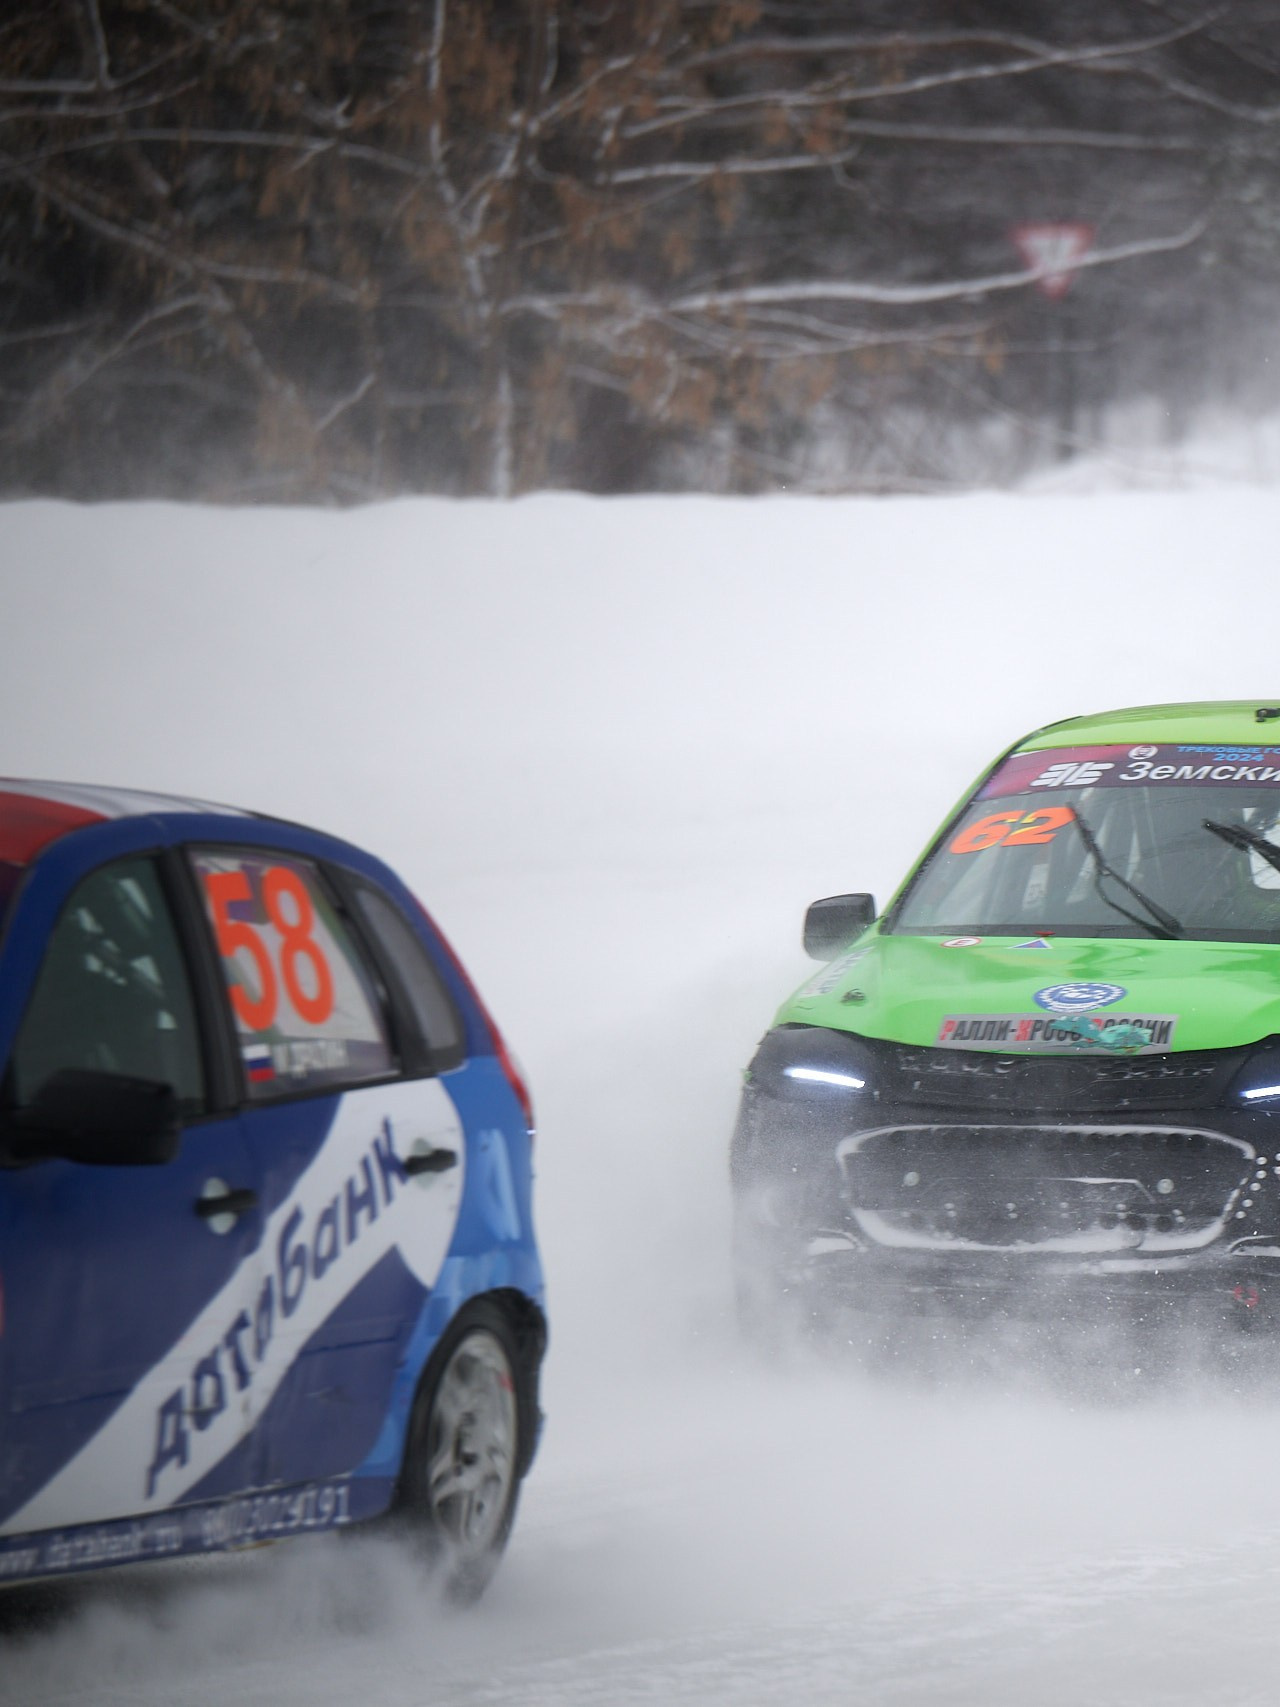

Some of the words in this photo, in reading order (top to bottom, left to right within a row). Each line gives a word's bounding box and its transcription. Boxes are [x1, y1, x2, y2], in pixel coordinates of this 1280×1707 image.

[1212, 753, 1265, 762] 2024
[950, 806, 1076, 854] 62
[203, 866, 334, 1032] 58
